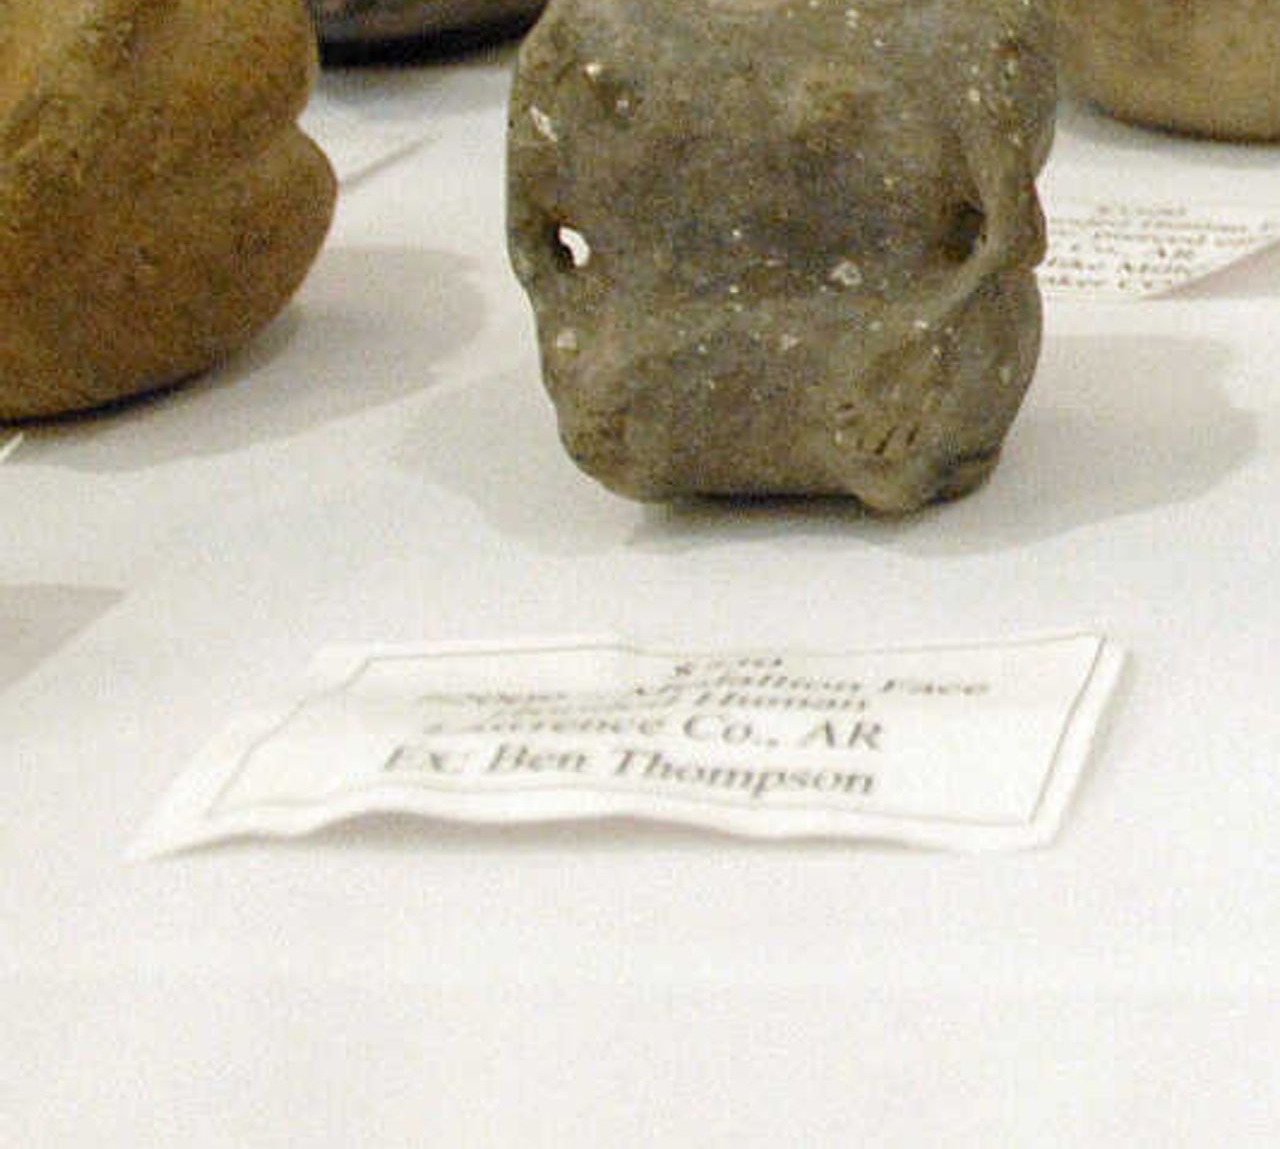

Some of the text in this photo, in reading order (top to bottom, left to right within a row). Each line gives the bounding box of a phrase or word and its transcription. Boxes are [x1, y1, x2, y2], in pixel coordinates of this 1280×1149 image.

[682, 713, 780, 748] Co.,
[800, 719, 885, 752] AR
[486, 743, 588, 773] Ben
[612, 745, 876, 799] Thompson
